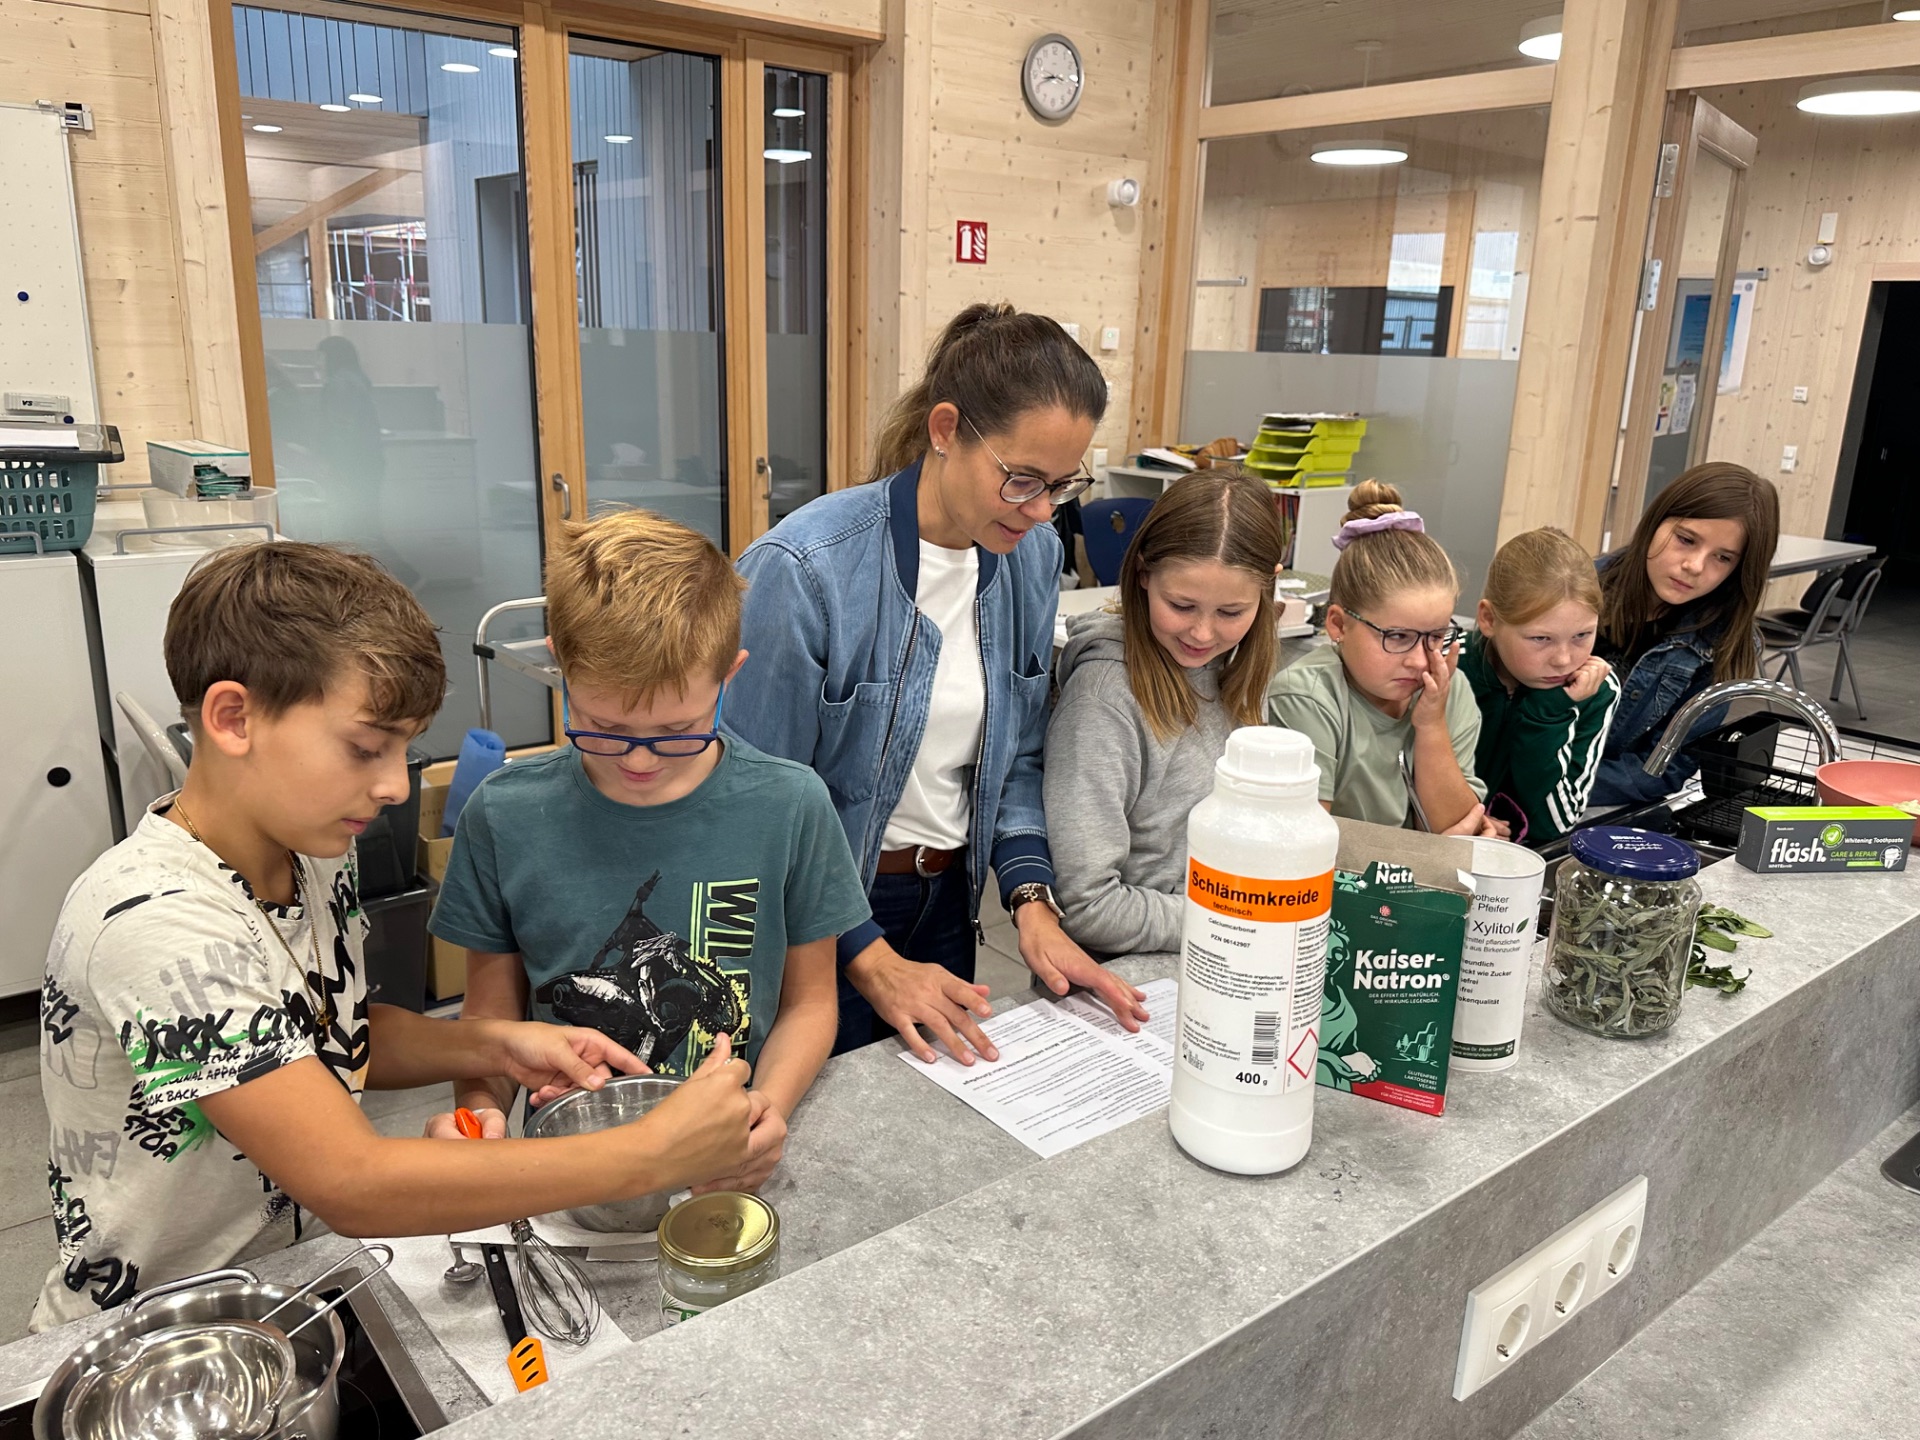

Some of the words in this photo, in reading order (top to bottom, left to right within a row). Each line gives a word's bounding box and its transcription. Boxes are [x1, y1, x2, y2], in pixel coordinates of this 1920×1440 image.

[1844, 837, 1872, 845] Whitening
[1874, 836, 1904, 844] Toothpaste
[1854, 850, 1878, 858] REPAIR
[1192, 870, 1319, 906] Schlämmkreide
[1213, 901, 1252, 916] technisch
[1478, 902, 1509, 913] Pfeifer
[1208, 918, 1256, 934] Calciumcarbonat
[1472, 920, 1514, 936] Xylitol
[1210, 934, 1222, 942] PZN
[1355, 948, 1445, 970] Kaiser-
[1462, 958, 1494, 968] eundlich
[1460, 986, 1473, 994] frei
[1235, 1072, 1260, 1084] 400
[1404, 1074, 1437, 1086] LAKTOSEFREI
[1407, 1070, 1438, 1080] GLUTENFREI
[166, 1088, 199, 1102] BACK
[124, 1115, 178, 1161] STOP
